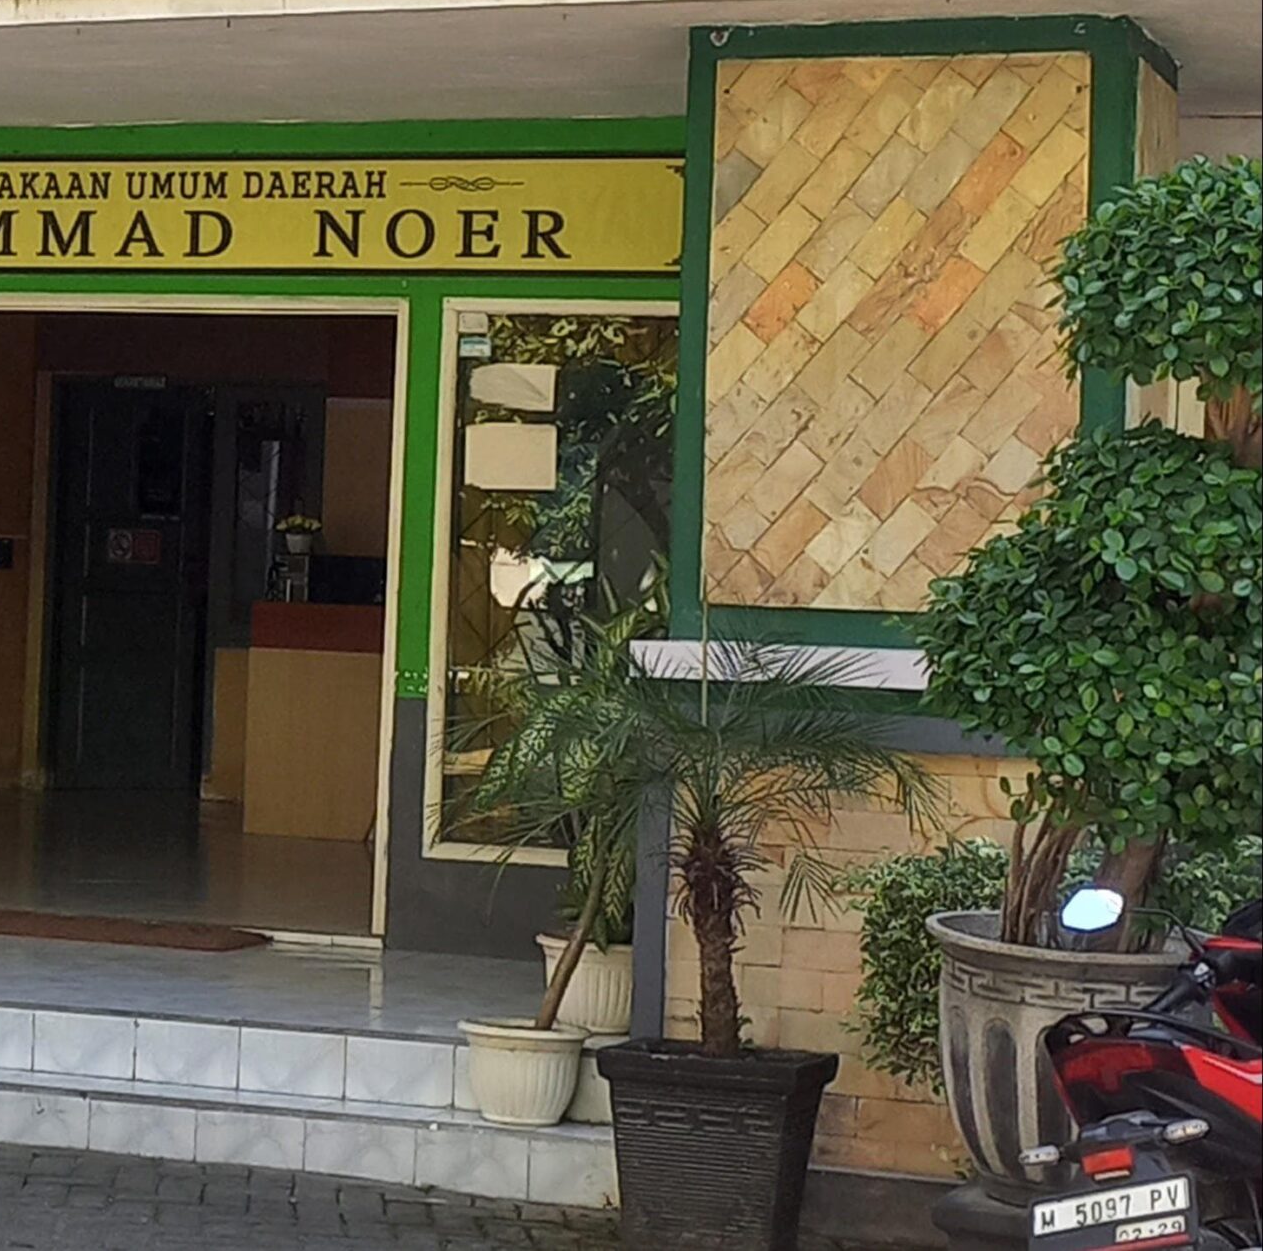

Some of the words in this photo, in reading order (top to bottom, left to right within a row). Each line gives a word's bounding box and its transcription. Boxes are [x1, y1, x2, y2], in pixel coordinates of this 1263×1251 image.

[125, 170, 229, 200] UMUM
[241, 170, 388, 200] DAERAH
[312, 208, 572, 259] NOER
[1041, 1209, 1055, 1231] M
[1075, 1193, 1131, 1227] 5097
[1149, 1184, 1178, 1211] PV
